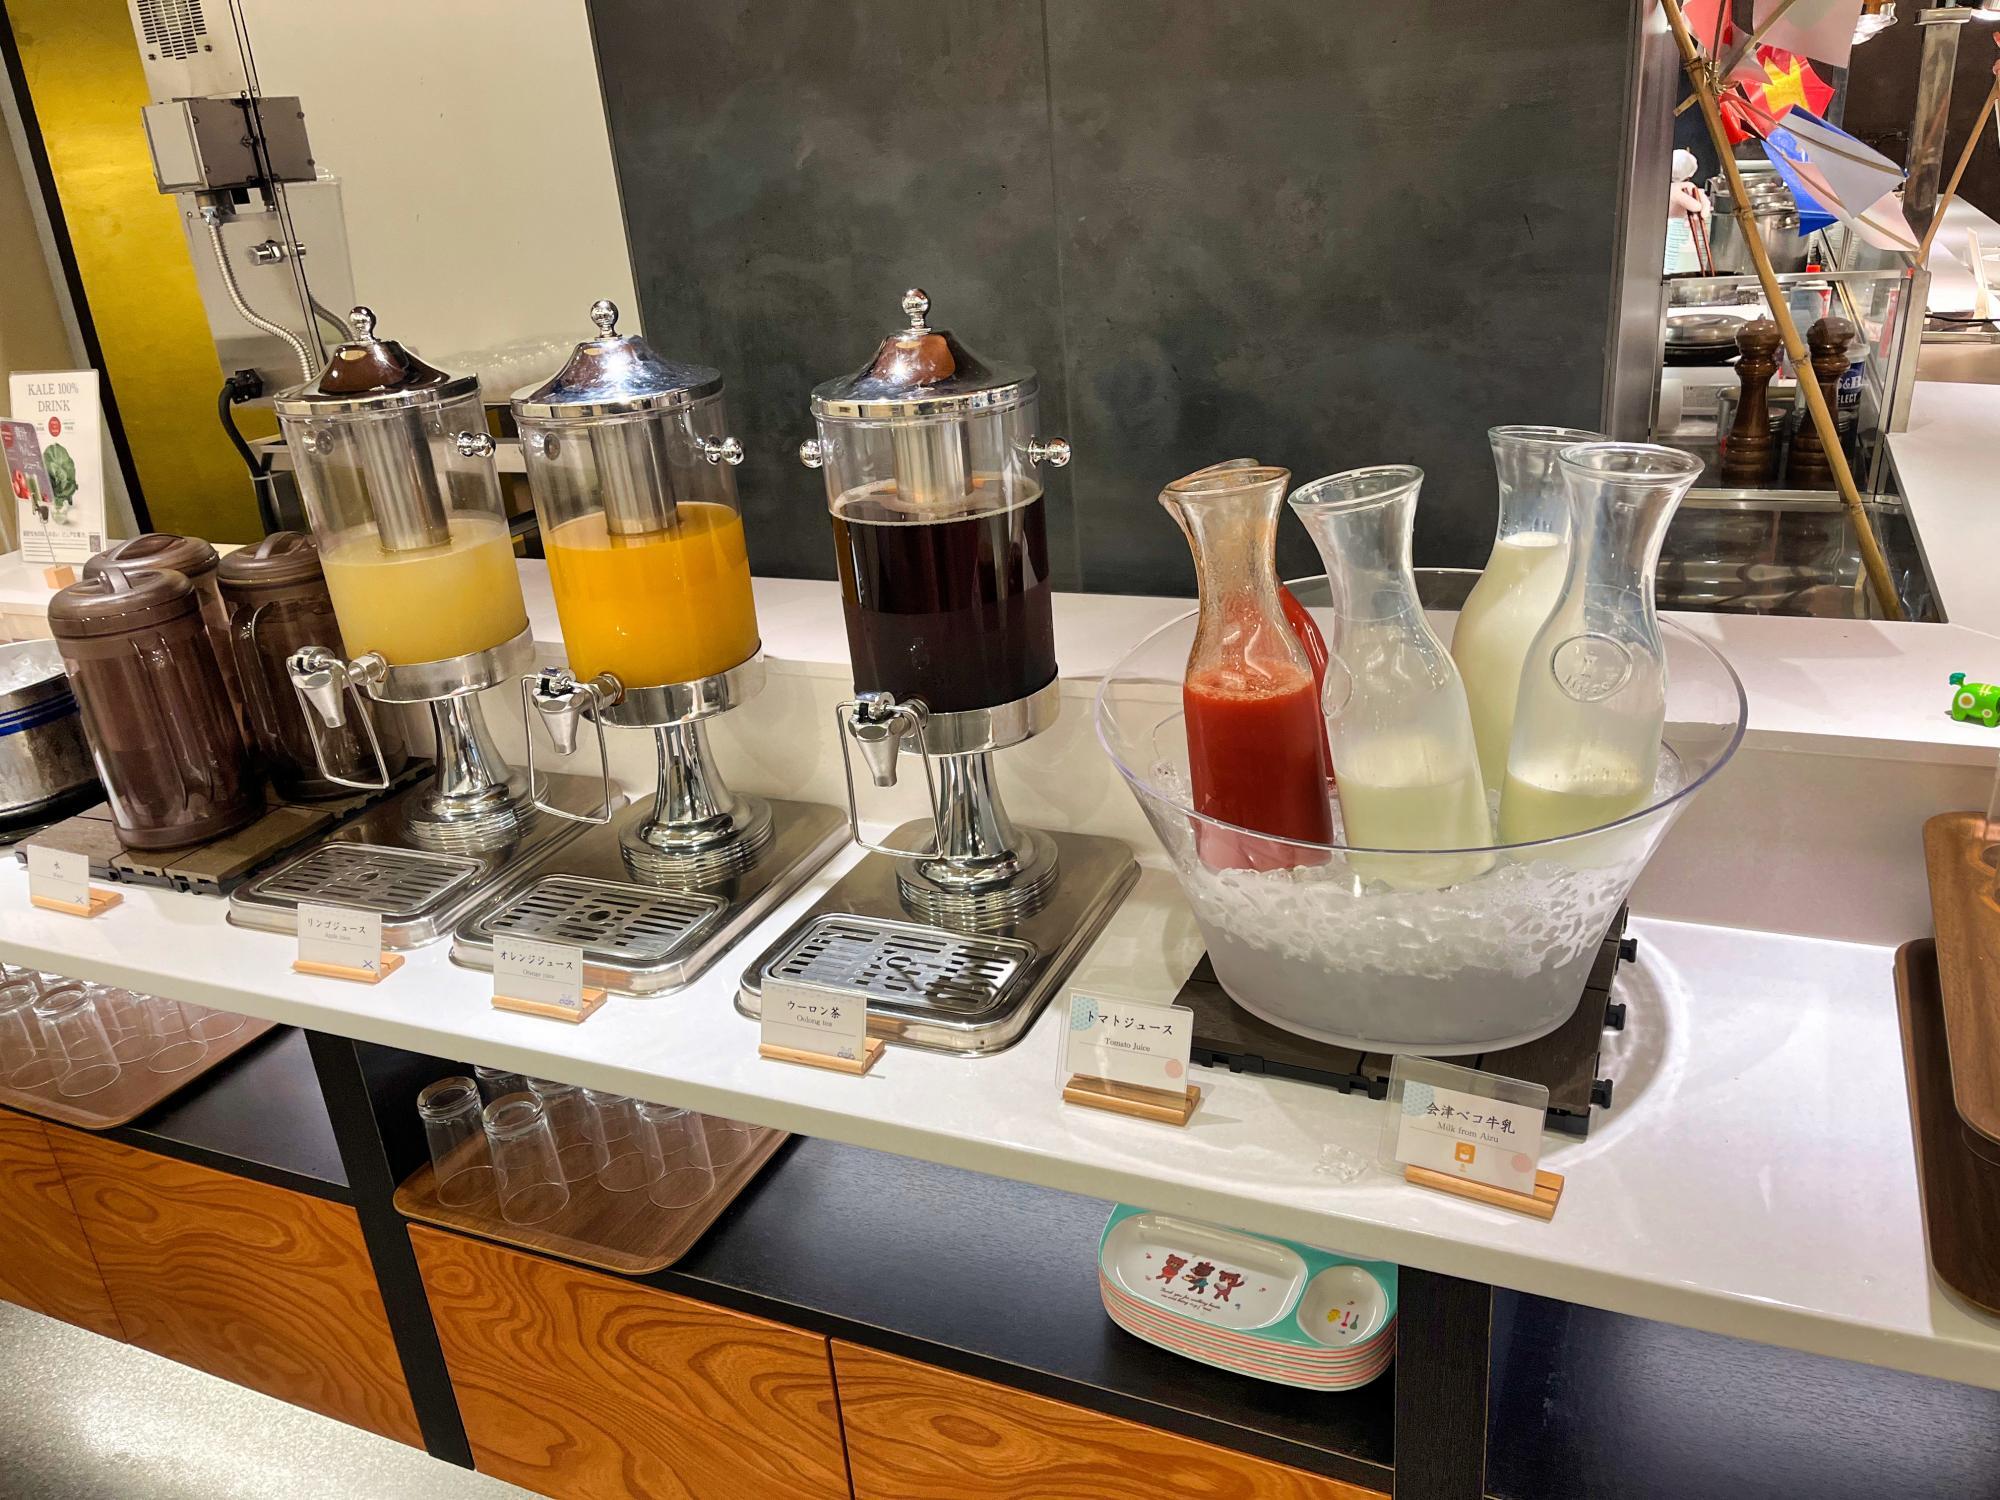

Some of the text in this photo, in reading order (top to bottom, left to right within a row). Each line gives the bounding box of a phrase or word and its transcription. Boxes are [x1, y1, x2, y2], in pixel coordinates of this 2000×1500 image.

[28, 382, 79, 396] KALE 100%
[38, 400, 71, 412] DRINK
[307, 917, 367, 935] リンゴジュース
[500, 950, 573, 970] オレンジジュース
[787, 1000, 841, 1020] ウーロン茶
[1088, 1009, 1173, 1036] トマトジュース
[1104, 1037, 1151, 1052] Tomato Juice
[1437, 1121, 1499, 1144] Milk from Aizu
